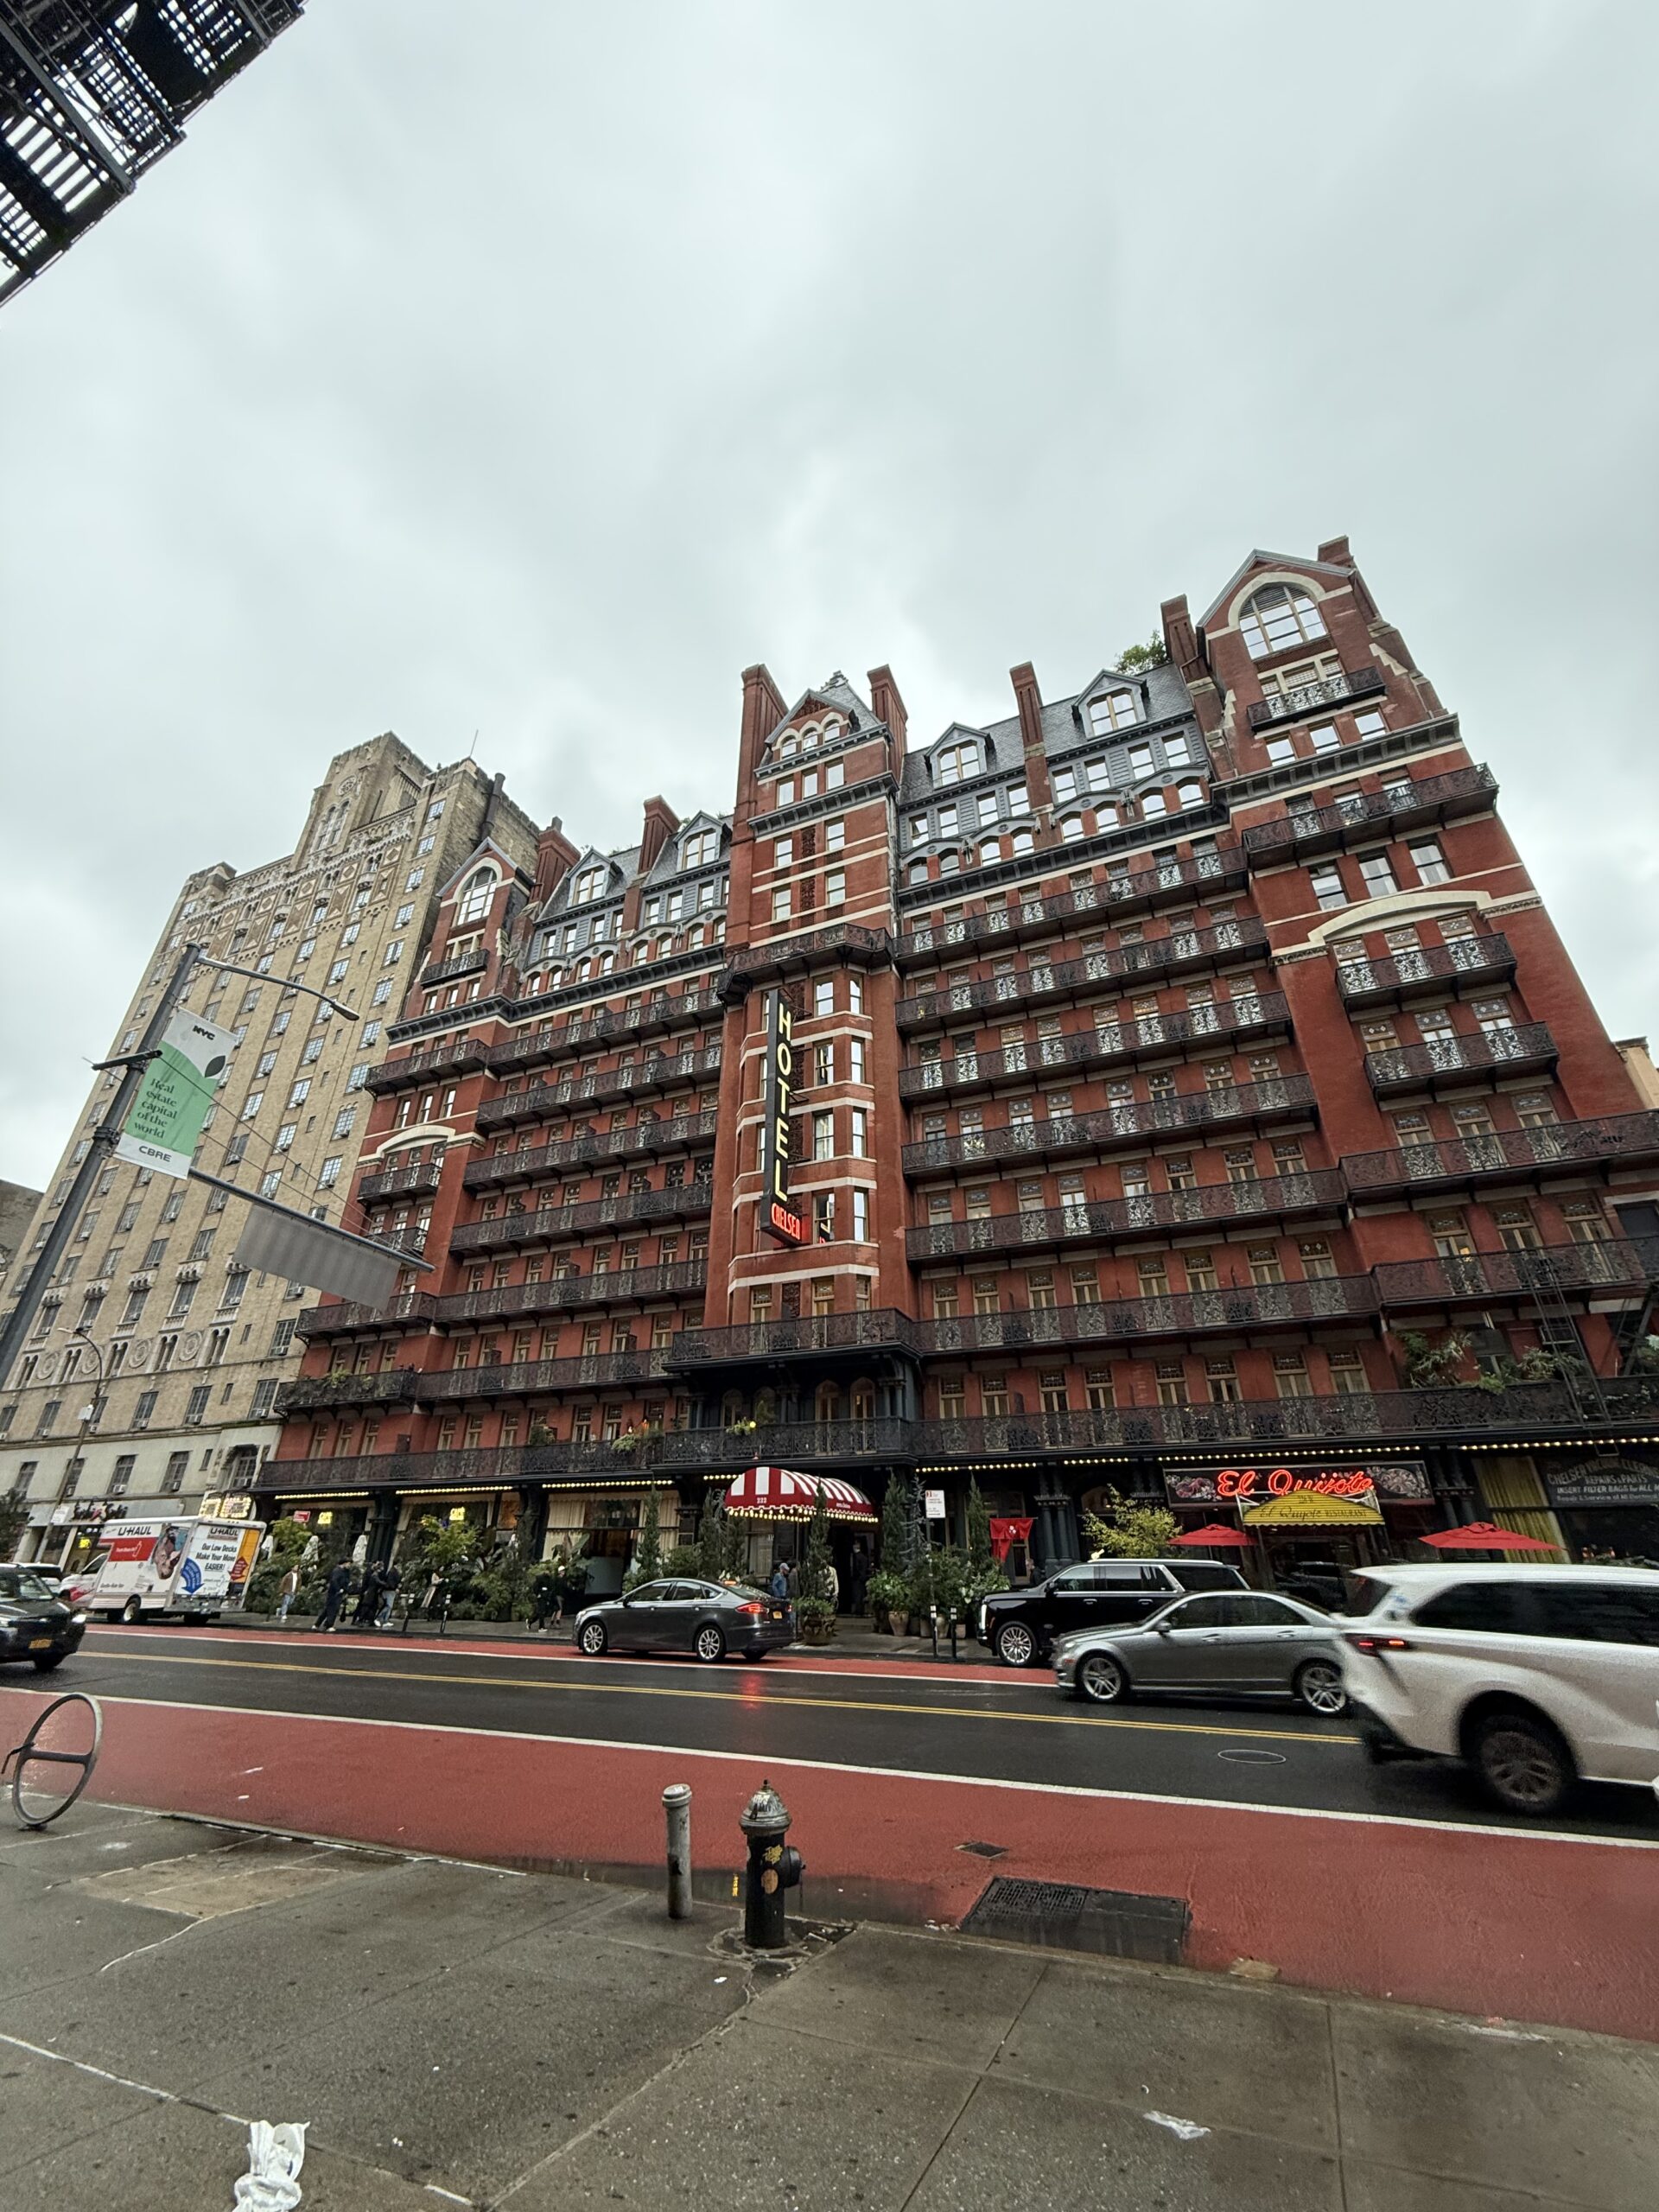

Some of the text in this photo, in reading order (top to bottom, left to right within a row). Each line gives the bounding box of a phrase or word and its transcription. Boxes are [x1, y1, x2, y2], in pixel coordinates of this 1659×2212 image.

[193, 1026, 215, 1040] NYC
[149, 1077, 175, 1095] Real
[145, 1090, 177, 1107] estate
[775, 1003, 791, 1202] HOTEL
[141, 1100, 178, 1120] capital
[137, 1110, 168, 1128] of the
[134, 1122, 165, 1138] world
[138, 1145, 172, 1162] CBRE
[771, 1202, 801, 1241] CHELSEA
[1547, 1463, 1587, 1484] CHELSEA
[1621, 1473, 1648, 1484] PARTS
[1217, 1469, 1374, 1496] El Quijote
[1583, 1484, 1607, 1494] FILTER
[1638, 1484, 1653, 1492] ALL
[1260, 1505, 1275, 1518] El
[118, 1525, 152, 1536] U-HAUL
[210, 1527, 238, 1535] U-HAUL
[211, 1543, 221, 1552] Low
[222, 1554, 236, 1562] Move
